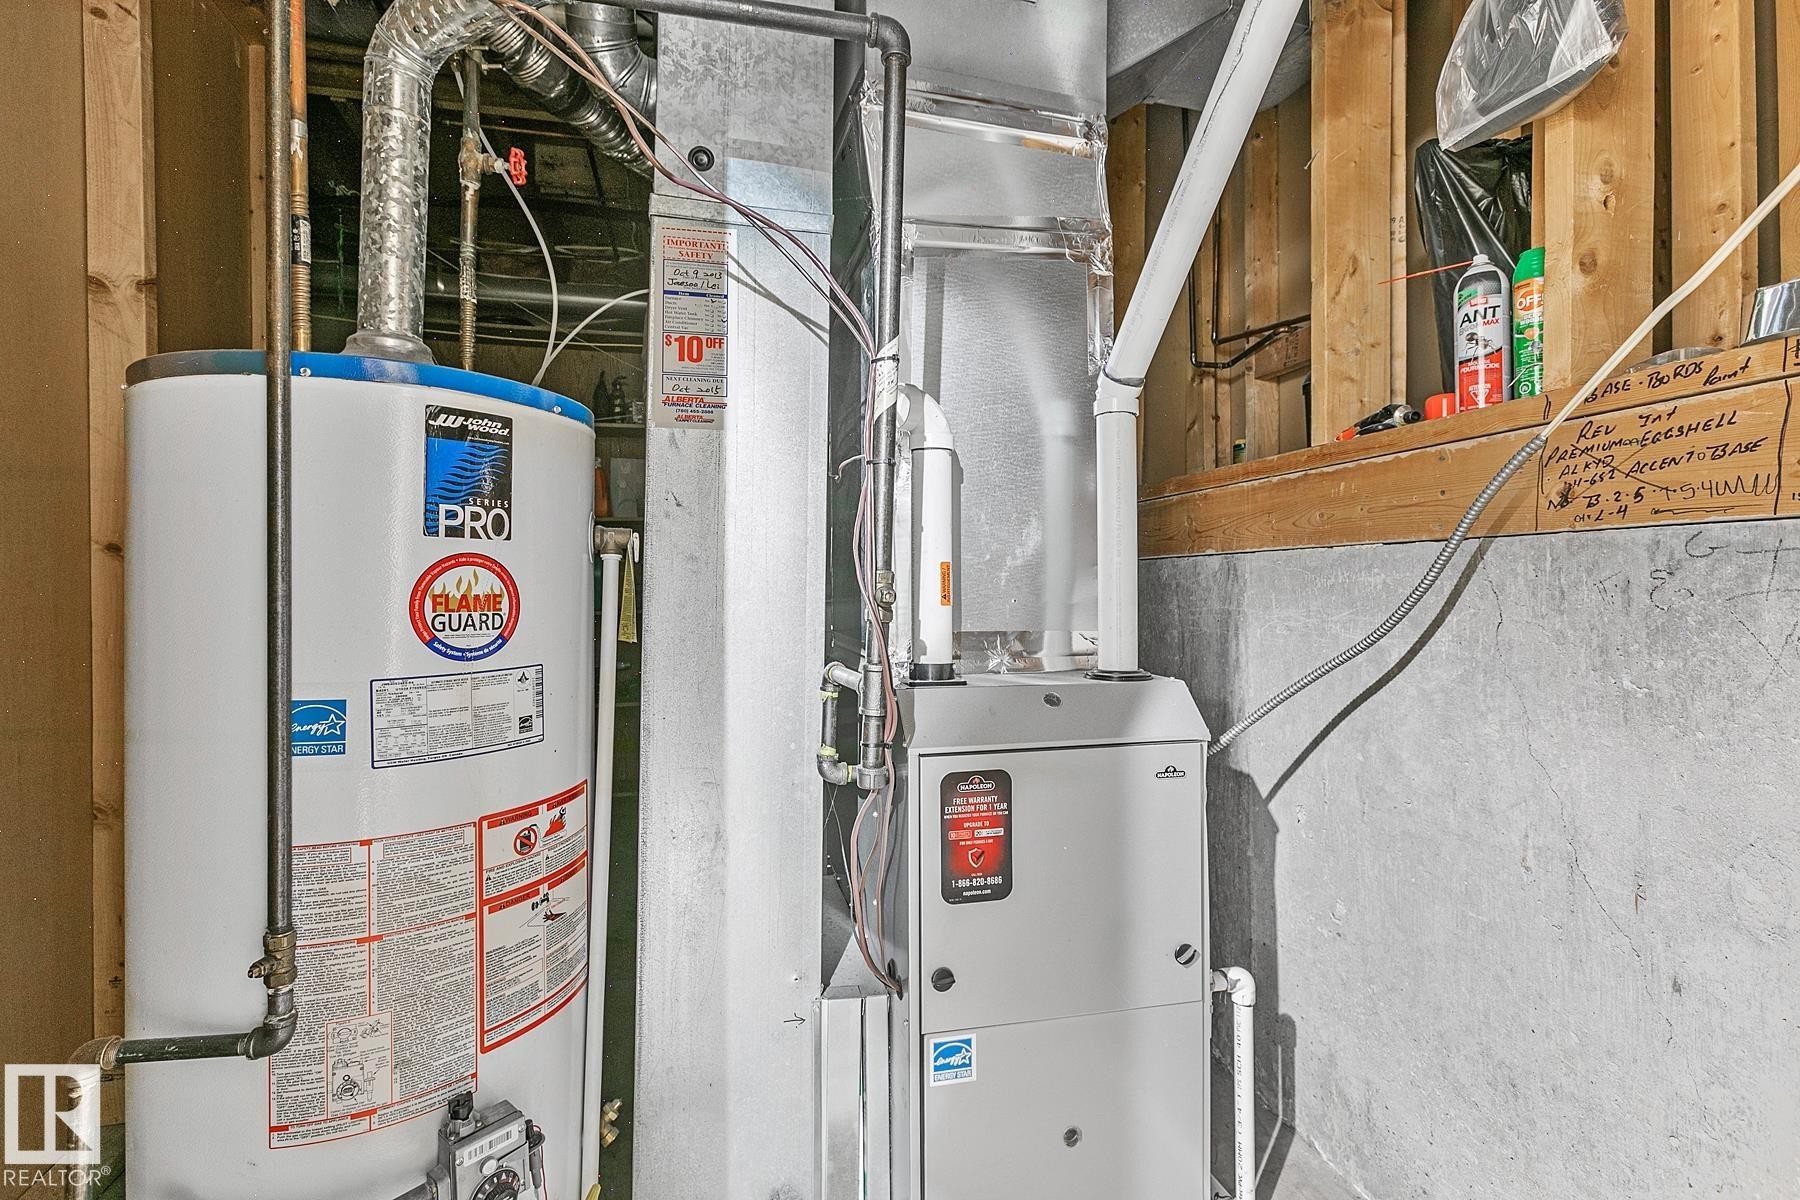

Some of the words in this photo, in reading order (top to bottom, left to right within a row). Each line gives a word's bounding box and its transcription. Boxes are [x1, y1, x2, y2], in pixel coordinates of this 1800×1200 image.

[667, 239, 726, 250] IMPORTANT!
[678, 250, 714, 260] SAFETY
[674, 268, 689, 277] Oct
[693, 270, 699, 280] 9
[1460, 305, 1500, 328] ANT
[1482, 318, 1500, 326] MAX
[706, 336, 724, 349] OFF
[672, 384, 690, 393] Oct
[696, 386, 722, 394] 2015
[463, 418, 502, 429] John
[469, 497, 509, 508] SERIES
[438, 504, 510, 542] PRO
[431, 593, 503, 614] FLAME
[430, 612, 504, 633] GUARD
[433, 641, 446, 652] Safety
[446, 648, 462, 657] System
[292, 746, 320, 756] NERGY
[321, 744, 344, 754] STAR
[968, 796, 998, 804] WARRANTY
[945, 805, 975, 814] EXTENSION
[505, 810, 532, 824] WARNING
[505, 894, 531, 908] DANGER
[934, 1072, 957, 1082] ENERGY
[957, 1070, 972, 1079] STAR
